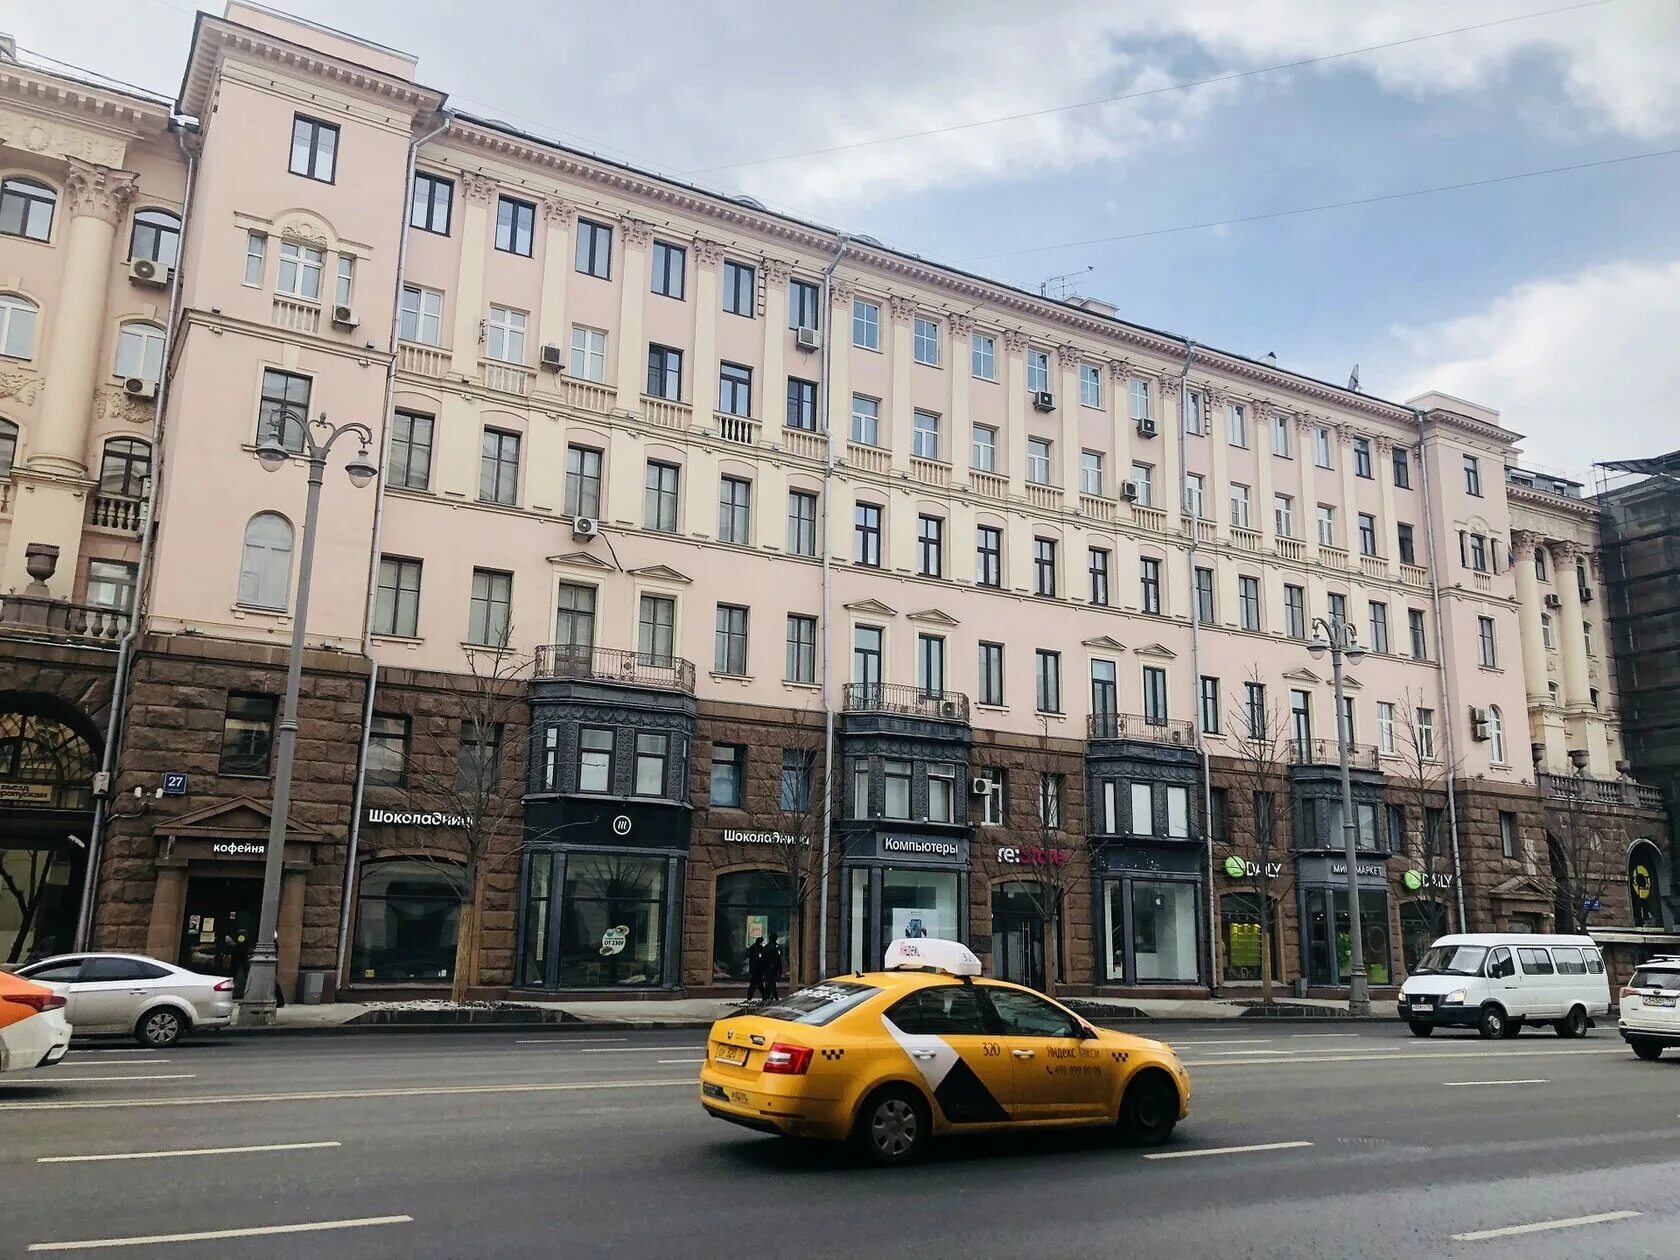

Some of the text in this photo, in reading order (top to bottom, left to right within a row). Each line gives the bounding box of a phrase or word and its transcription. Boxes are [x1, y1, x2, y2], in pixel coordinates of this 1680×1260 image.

[168, 776, 184, 787] 27
[213, 842, 265, 855] кофейня
[885, 837, 958, 856] Компьютеры
[982, 1042, 1000, 1057] 320
[1046, 1044, 1076, 1059] Яндекс
